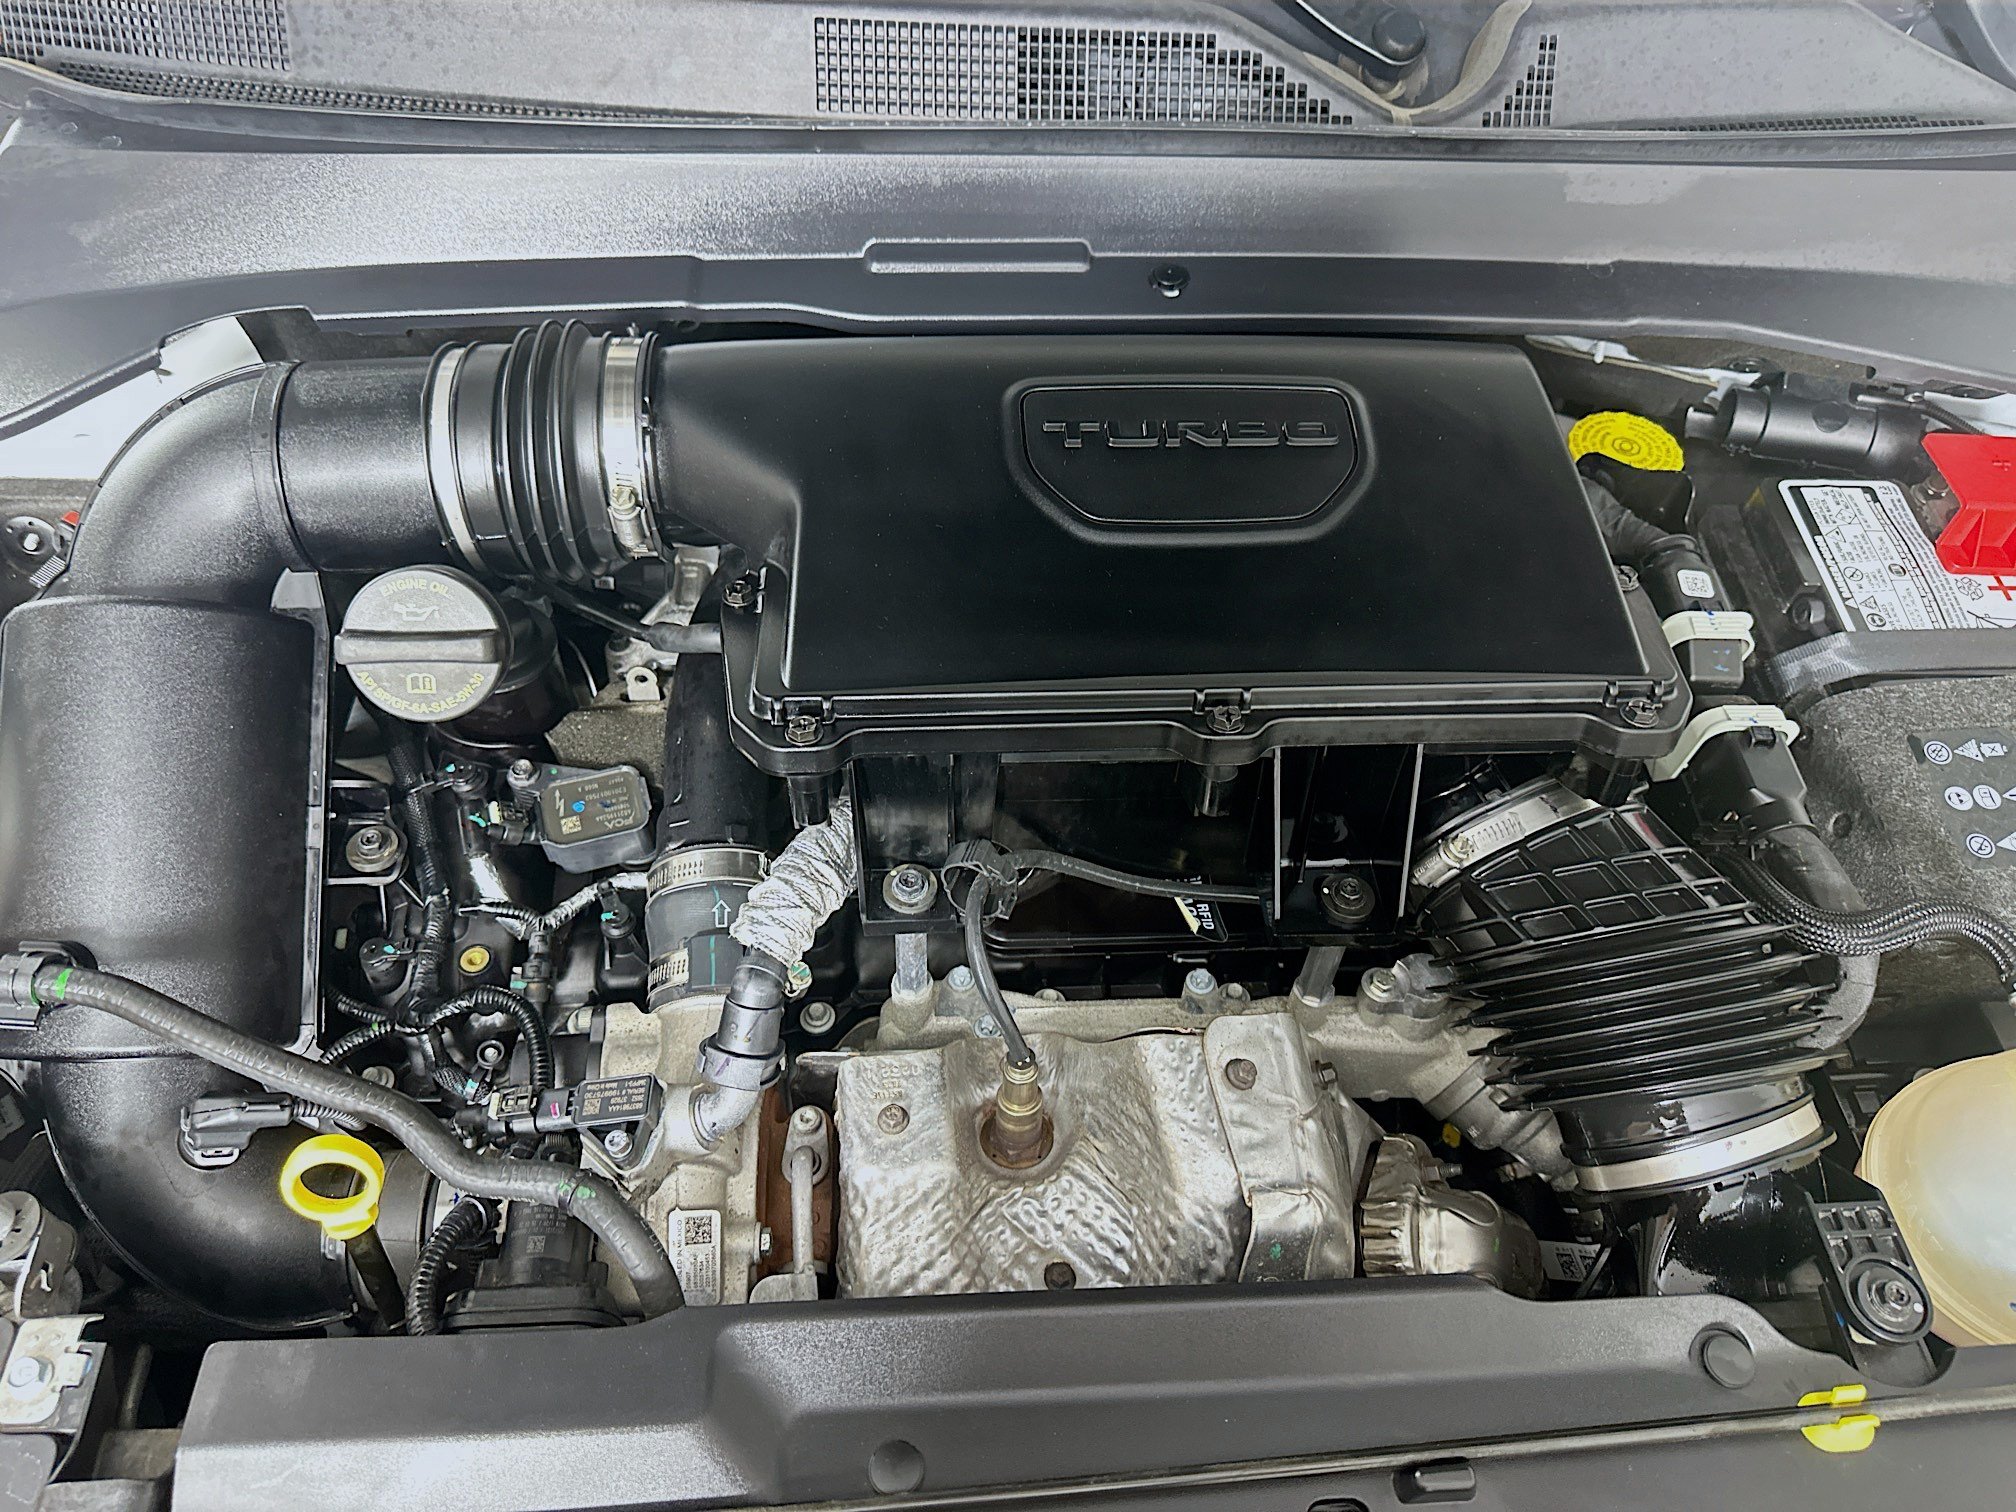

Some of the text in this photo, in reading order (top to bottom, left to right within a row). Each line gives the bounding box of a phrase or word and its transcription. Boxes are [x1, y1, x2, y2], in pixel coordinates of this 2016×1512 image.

[1042, 419, 1340, 448] TURBO
[380, 578, 452, 599] ENGINE OIL
[357, 671, 377, 692] API
[1196, 903, 1215, 930] RFID
[627, 1087, 645, 1095] SERIAL
[676, 1249, 681, 1257] IN
